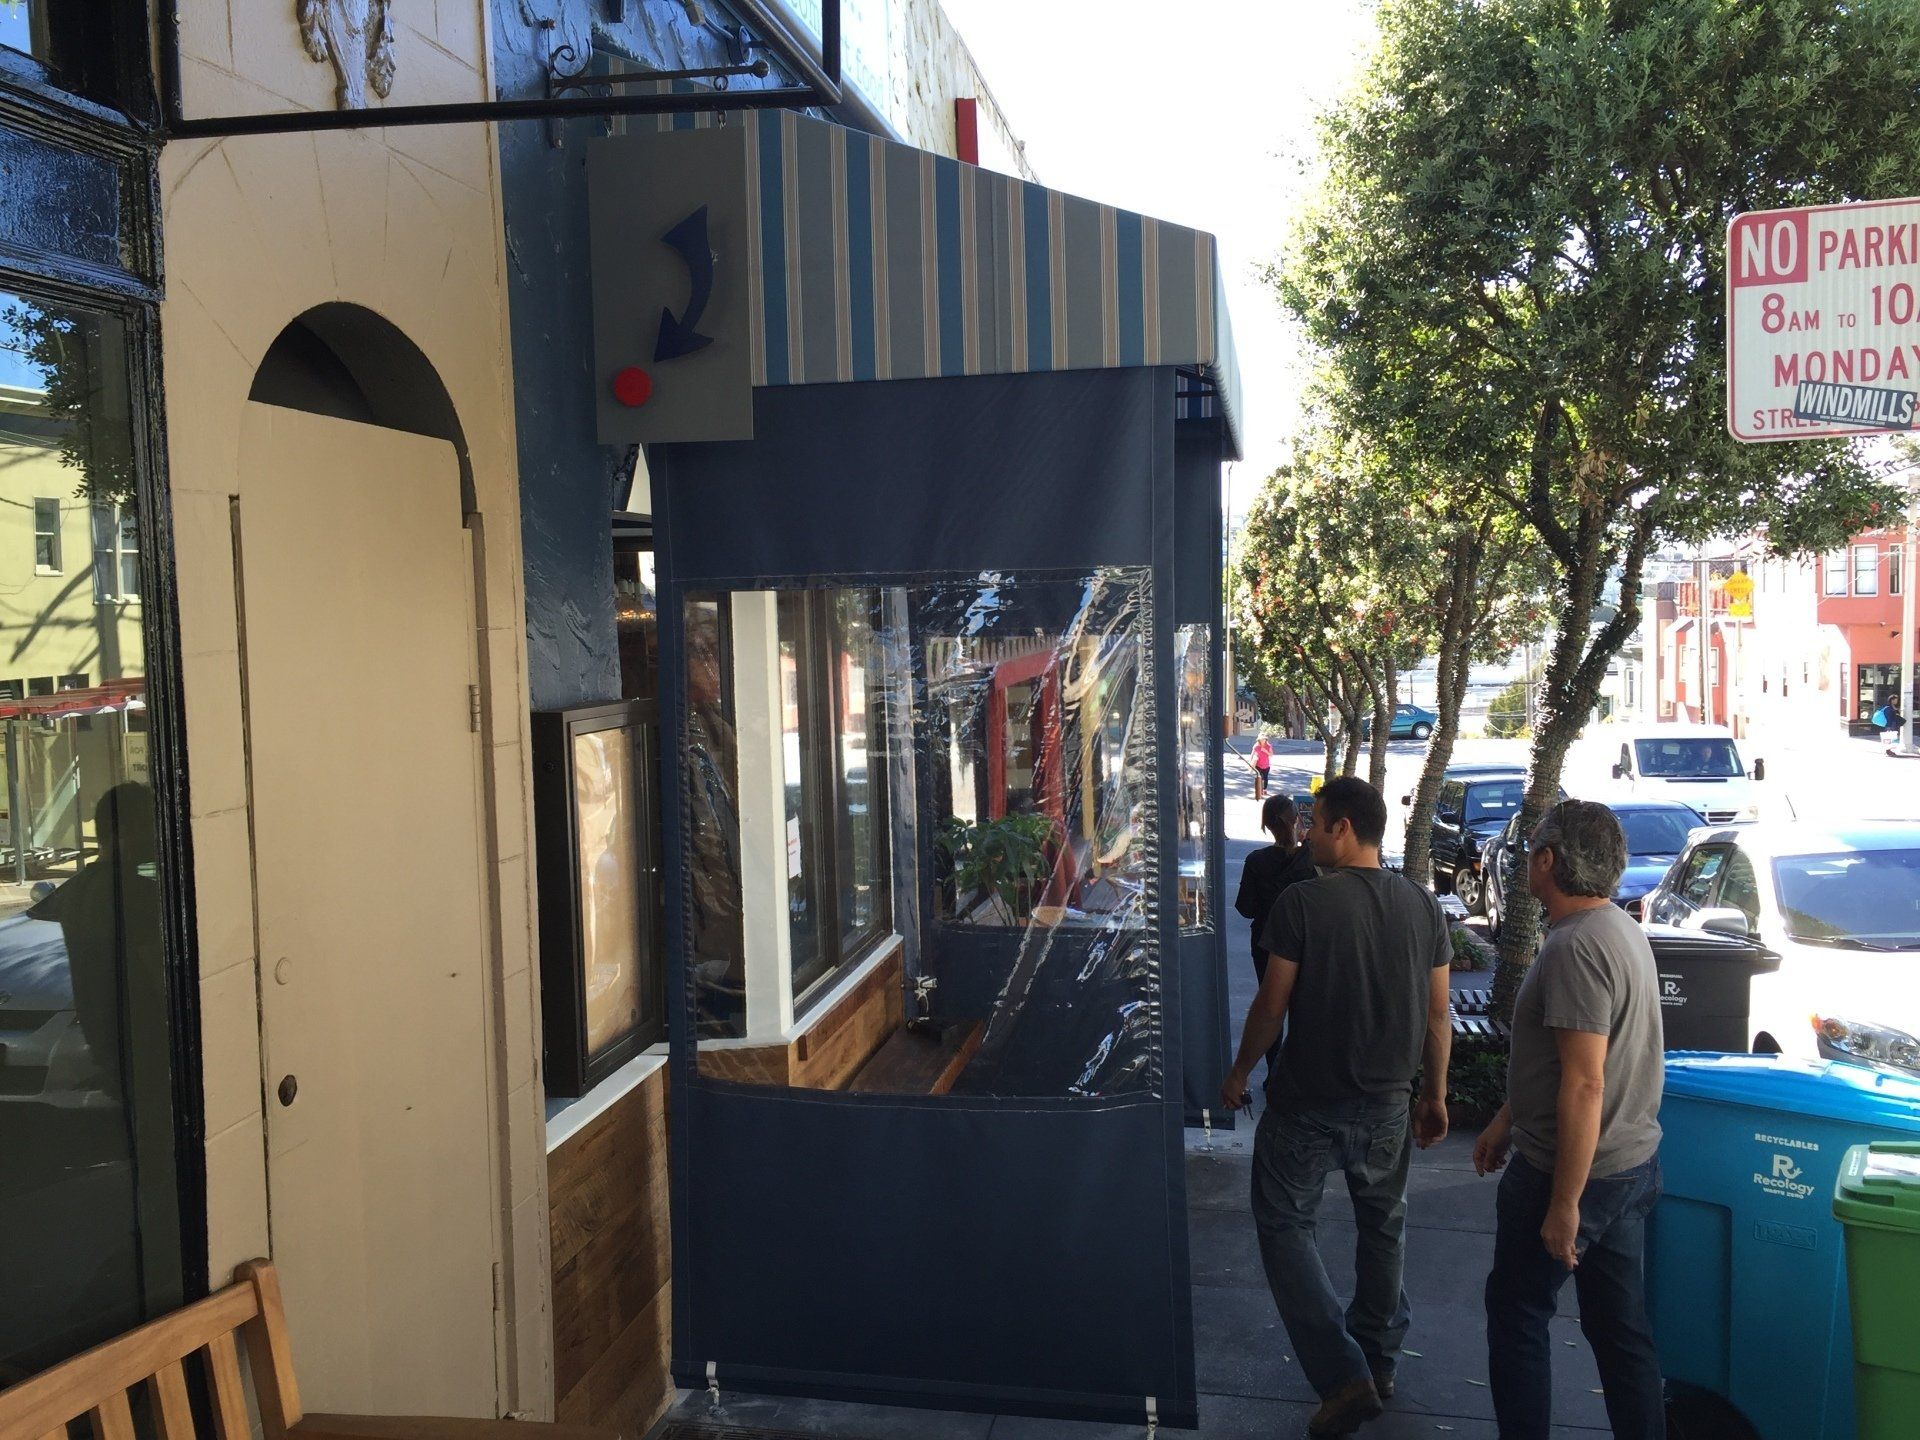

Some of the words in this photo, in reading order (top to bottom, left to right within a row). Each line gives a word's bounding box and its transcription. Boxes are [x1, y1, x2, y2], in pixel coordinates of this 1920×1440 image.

[1741, 219, 1798, 278] NO
[1818, 223, 1918, 271] PARKI
[1761, 292, 1820, 334] 8AM
[1837, 313, 1857, 329] TO
[1872, 282, 1920, 326] 10
[1799, 382, 1914, 424] WINDMILLS
[1658, 995, 1688, 1004] ecology
[1754, 1132, 1820, 1152] RECYCLABLES
[1753, 1173, 1815, 1197] Recology
